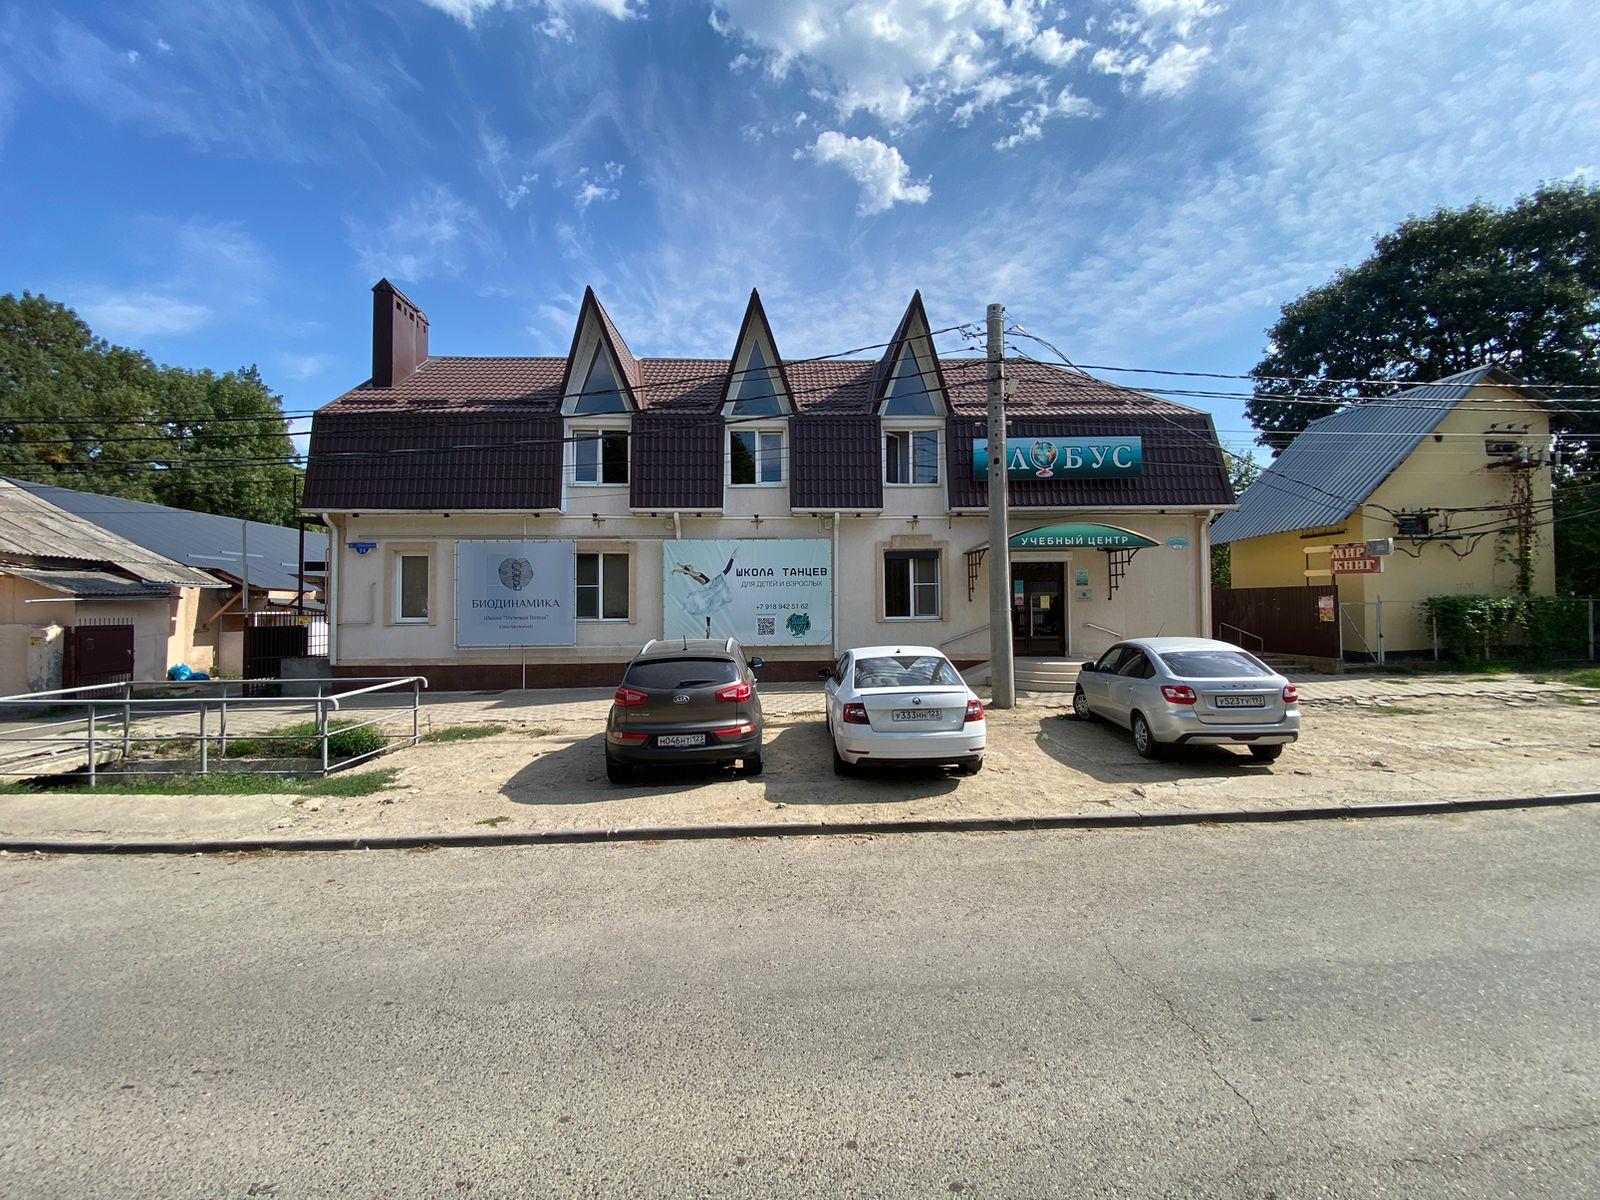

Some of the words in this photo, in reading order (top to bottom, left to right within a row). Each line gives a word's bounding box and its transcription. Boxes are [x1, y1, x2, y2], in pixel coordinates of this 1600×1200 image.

[986, 442, 1132, 475] ЛОБУС
[1021, 535, 1083, 546] УЧЕБНЫЙ
[1088, 536, 1129, 546] ЦЕНТР
[1331, 547, 1366, 558] МИР
[1334, 559, 1375, 570] КНИГ
[735, 567, 774, 577] ШКОЛА
[782, 567, 828, 577] ТАНЦЕВ
[756, 580, 778, 588] ДЕТЕЙ
[472, 599, 560, 610] БИОДИНАМИКА
